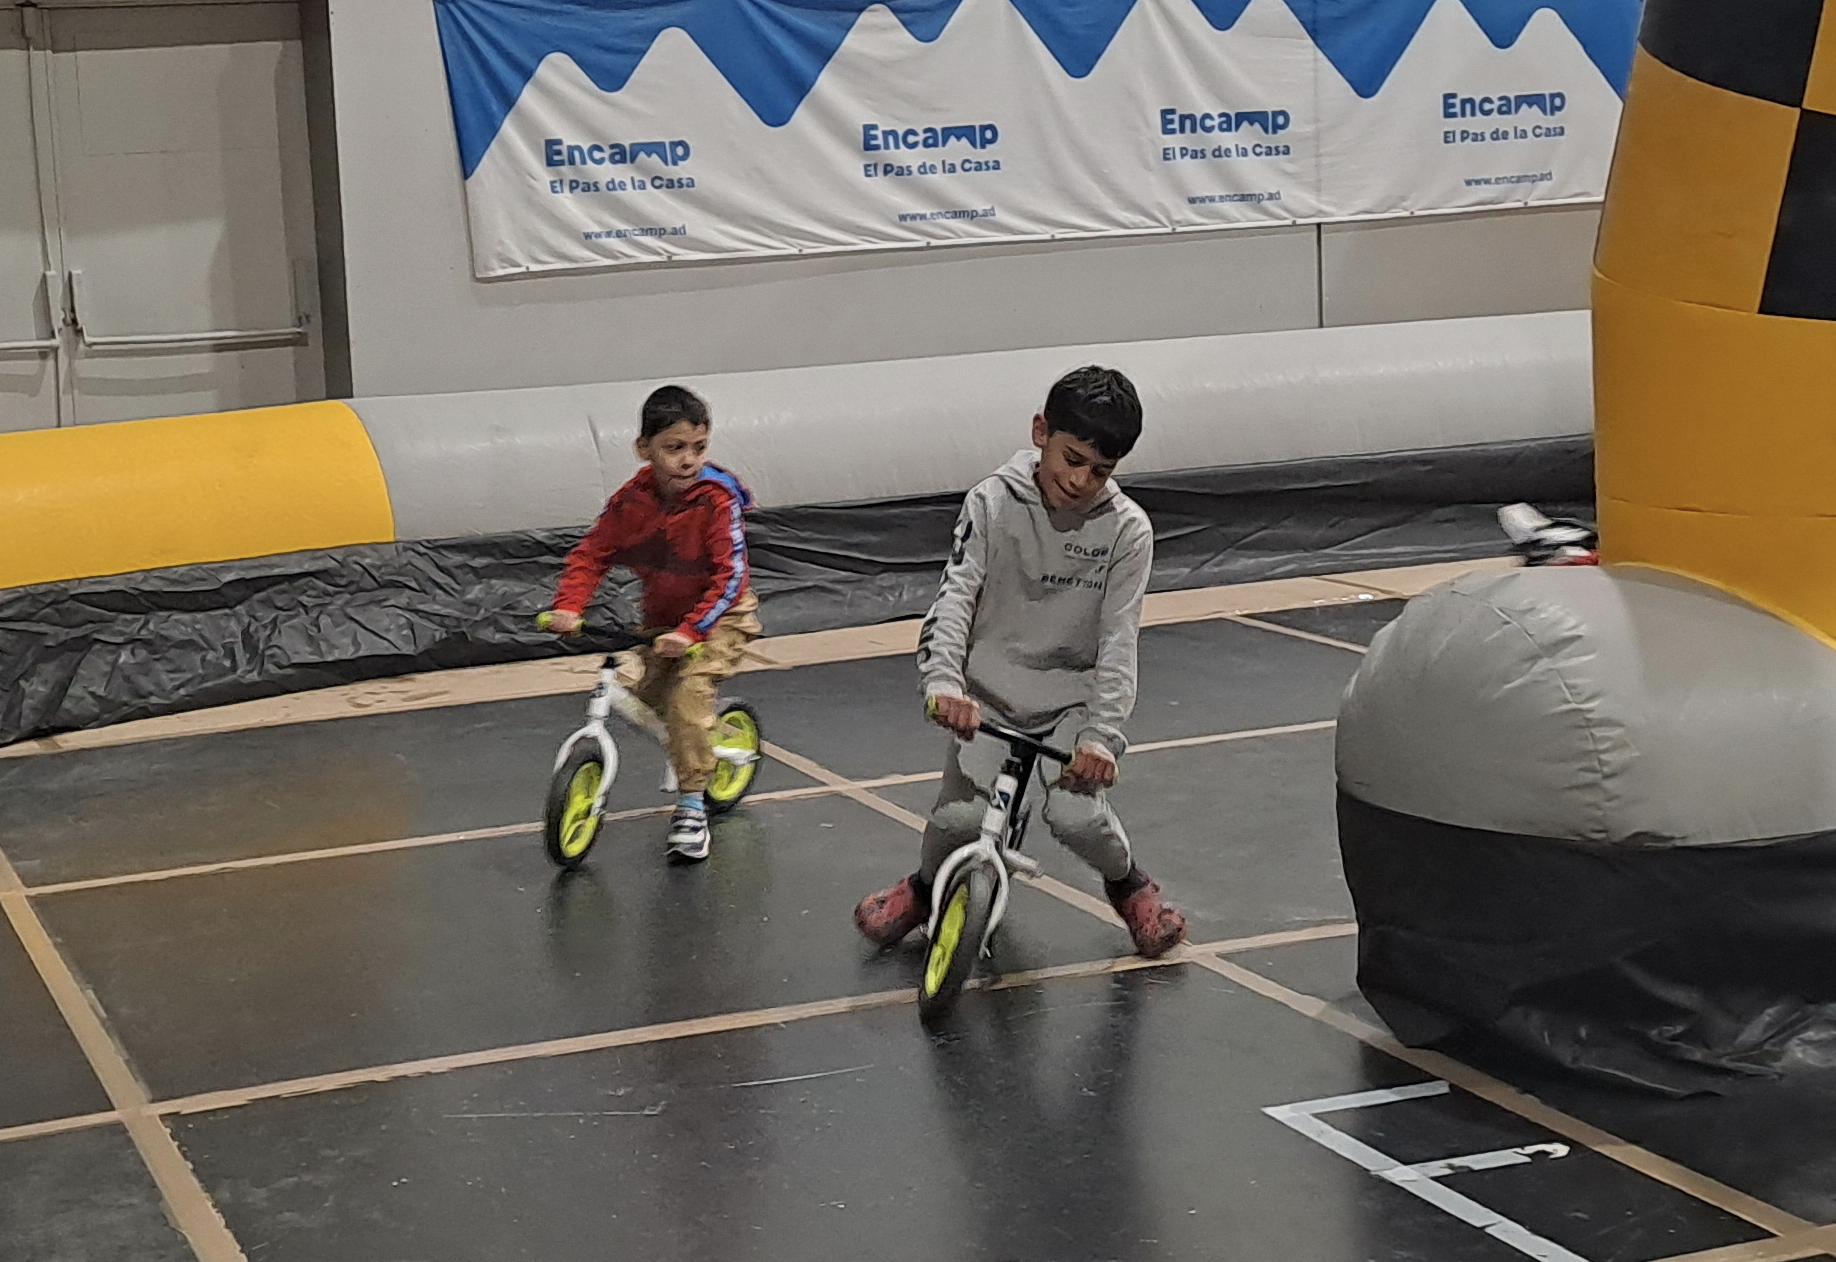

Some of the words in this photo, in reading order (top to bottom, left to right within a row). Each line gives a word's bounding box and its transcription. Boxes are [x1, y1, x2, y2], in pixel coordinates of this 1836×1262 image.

[1443, 92, 1566, 119] Encamp
[1160, 108, 1290, 135] Encamp
[862, 124, 998, 151] Encamp
[1444, 130, 1455, 144] El
[1460, 130, 1485, 142] Pas
[1490, 128, 1509, 141] de
[1514, 126, 1528, 139] la
[1532, 125, 1565, 138] Casa
[545, 139, 690, 167] Encamp
[1162, 147, 1175, 161] El
[1180, 147, 1206, 159] Pas
[1212, 145, 1232, 158] de
[1235, 144, 1248, 157] la
[1252, 143, 1291, 156] Casa
[864, 163, 878, 177] El
[883, 163, 913, 177] Pas
[917, 161, 937, 175] de
[942, 159, 956, 173] la
[961, 159, 1001, 172] Casa
[550, 179, 564, 193] El
[569, 179, 600, 193] Pas
[605, 178, 627, 191] de
[631, 176, 647, 190] la
[651, 175, 695, 189] Casa
[1464, 171, 1552, 187] www.encamp.ad
[1188, 190, 1281, 204] www.encamp.ad
[898, 206, 996, 222] www.encamp.ad
[583, 224, 686, 240] www.encamp.ad
